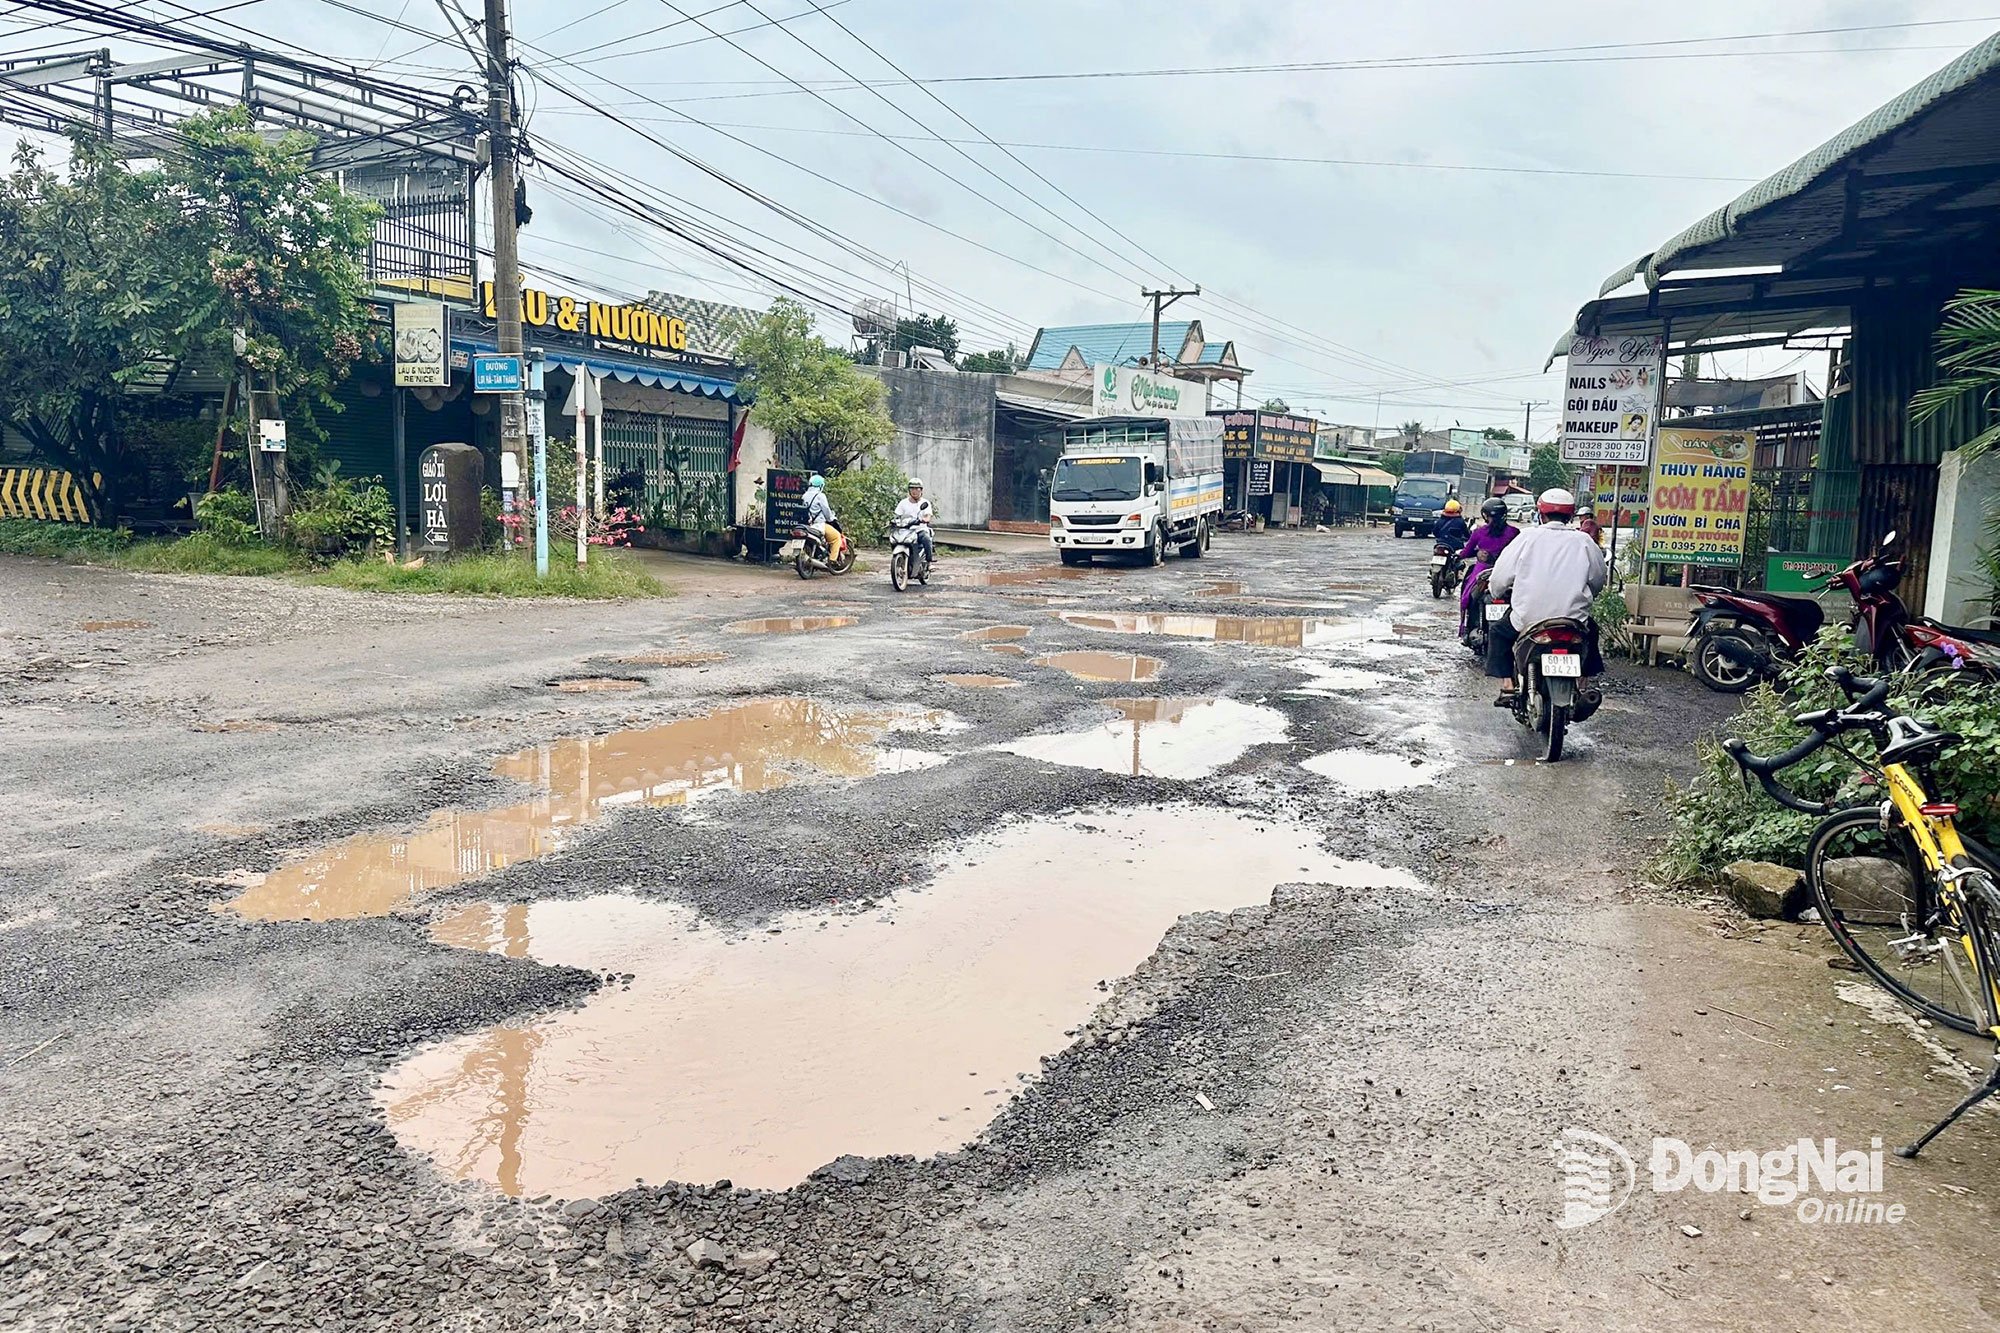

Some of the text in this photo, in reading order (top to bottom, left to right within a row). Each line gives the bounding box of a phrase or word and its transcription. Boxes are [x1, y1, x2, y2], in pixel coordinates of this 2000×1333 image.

[557, 296, 580, 332] &
[588, 300, 687, 350] NƯỚNG
[1569, 377, 1607, 390] NAILS
[1568, 397, 1588, 413] GỘI
[1565, 421, 1618, 434] MAKEUP
[1579, 442, 1642, 451] 0328 300 749
[1578, 450, 1601, 458] 0399
[1625, 451, 1641, 459] 157
[424, 481, 448, 507] LỢI
[1597, 492, 1617, 503] NƯỚ
[1654, 479, 1747, 513] CƠM TẤM
[426, 505, 448, 528] HÀ
[1652, 513, 1687, 527] SƯỜN
[1715, 515, 1741, 530] CHẢ
[1652, 541, 1739, 553] ĐT: 0395 270 543
